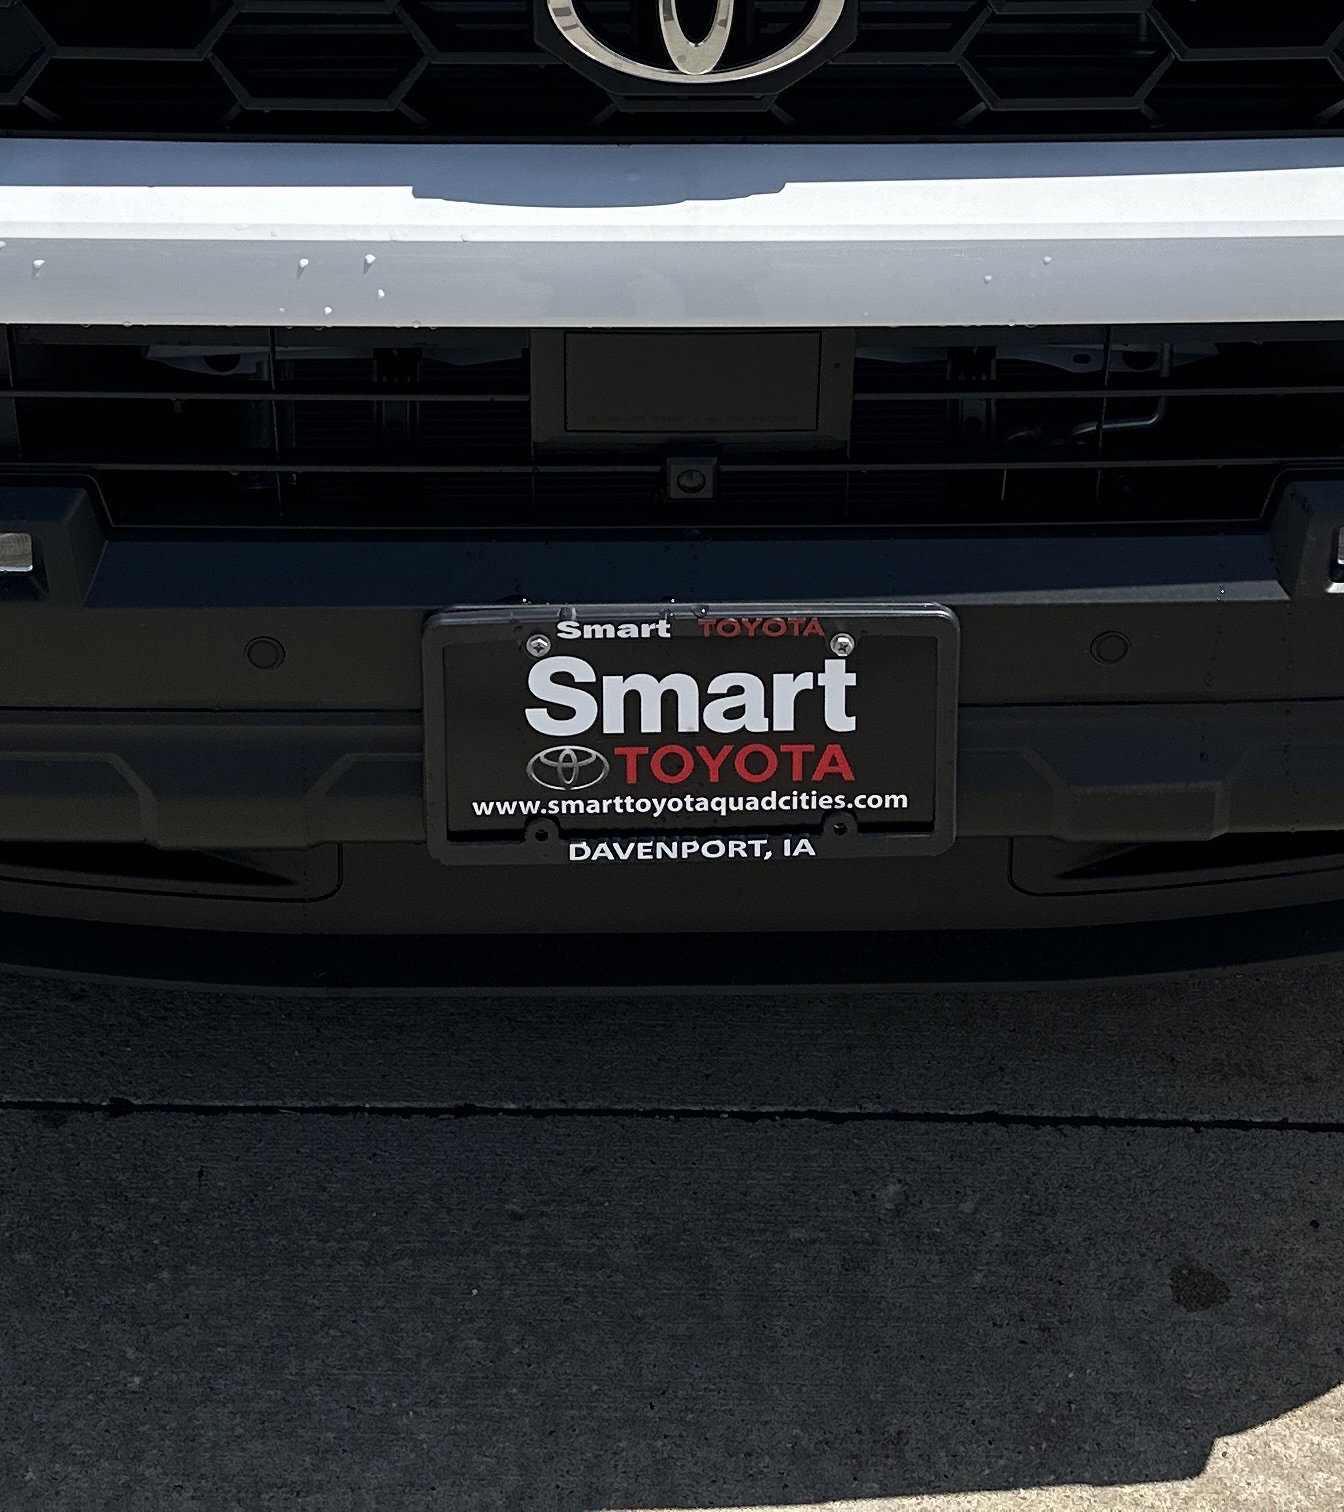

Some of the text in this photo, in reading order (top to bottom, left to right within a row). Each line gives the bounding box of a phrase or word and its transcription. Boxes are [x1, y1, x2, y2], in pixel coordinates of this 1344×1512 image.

[556, 618, 824, 639] Smart TOYOTA
[525, 655, 857, 737] Smart
[614, 744, 855, 784] TOYOTA
[471, 790, 908, 817] www.smarttoyotaquadcities.com
[568, 838, 816, 861] DAVENPORT, IA
